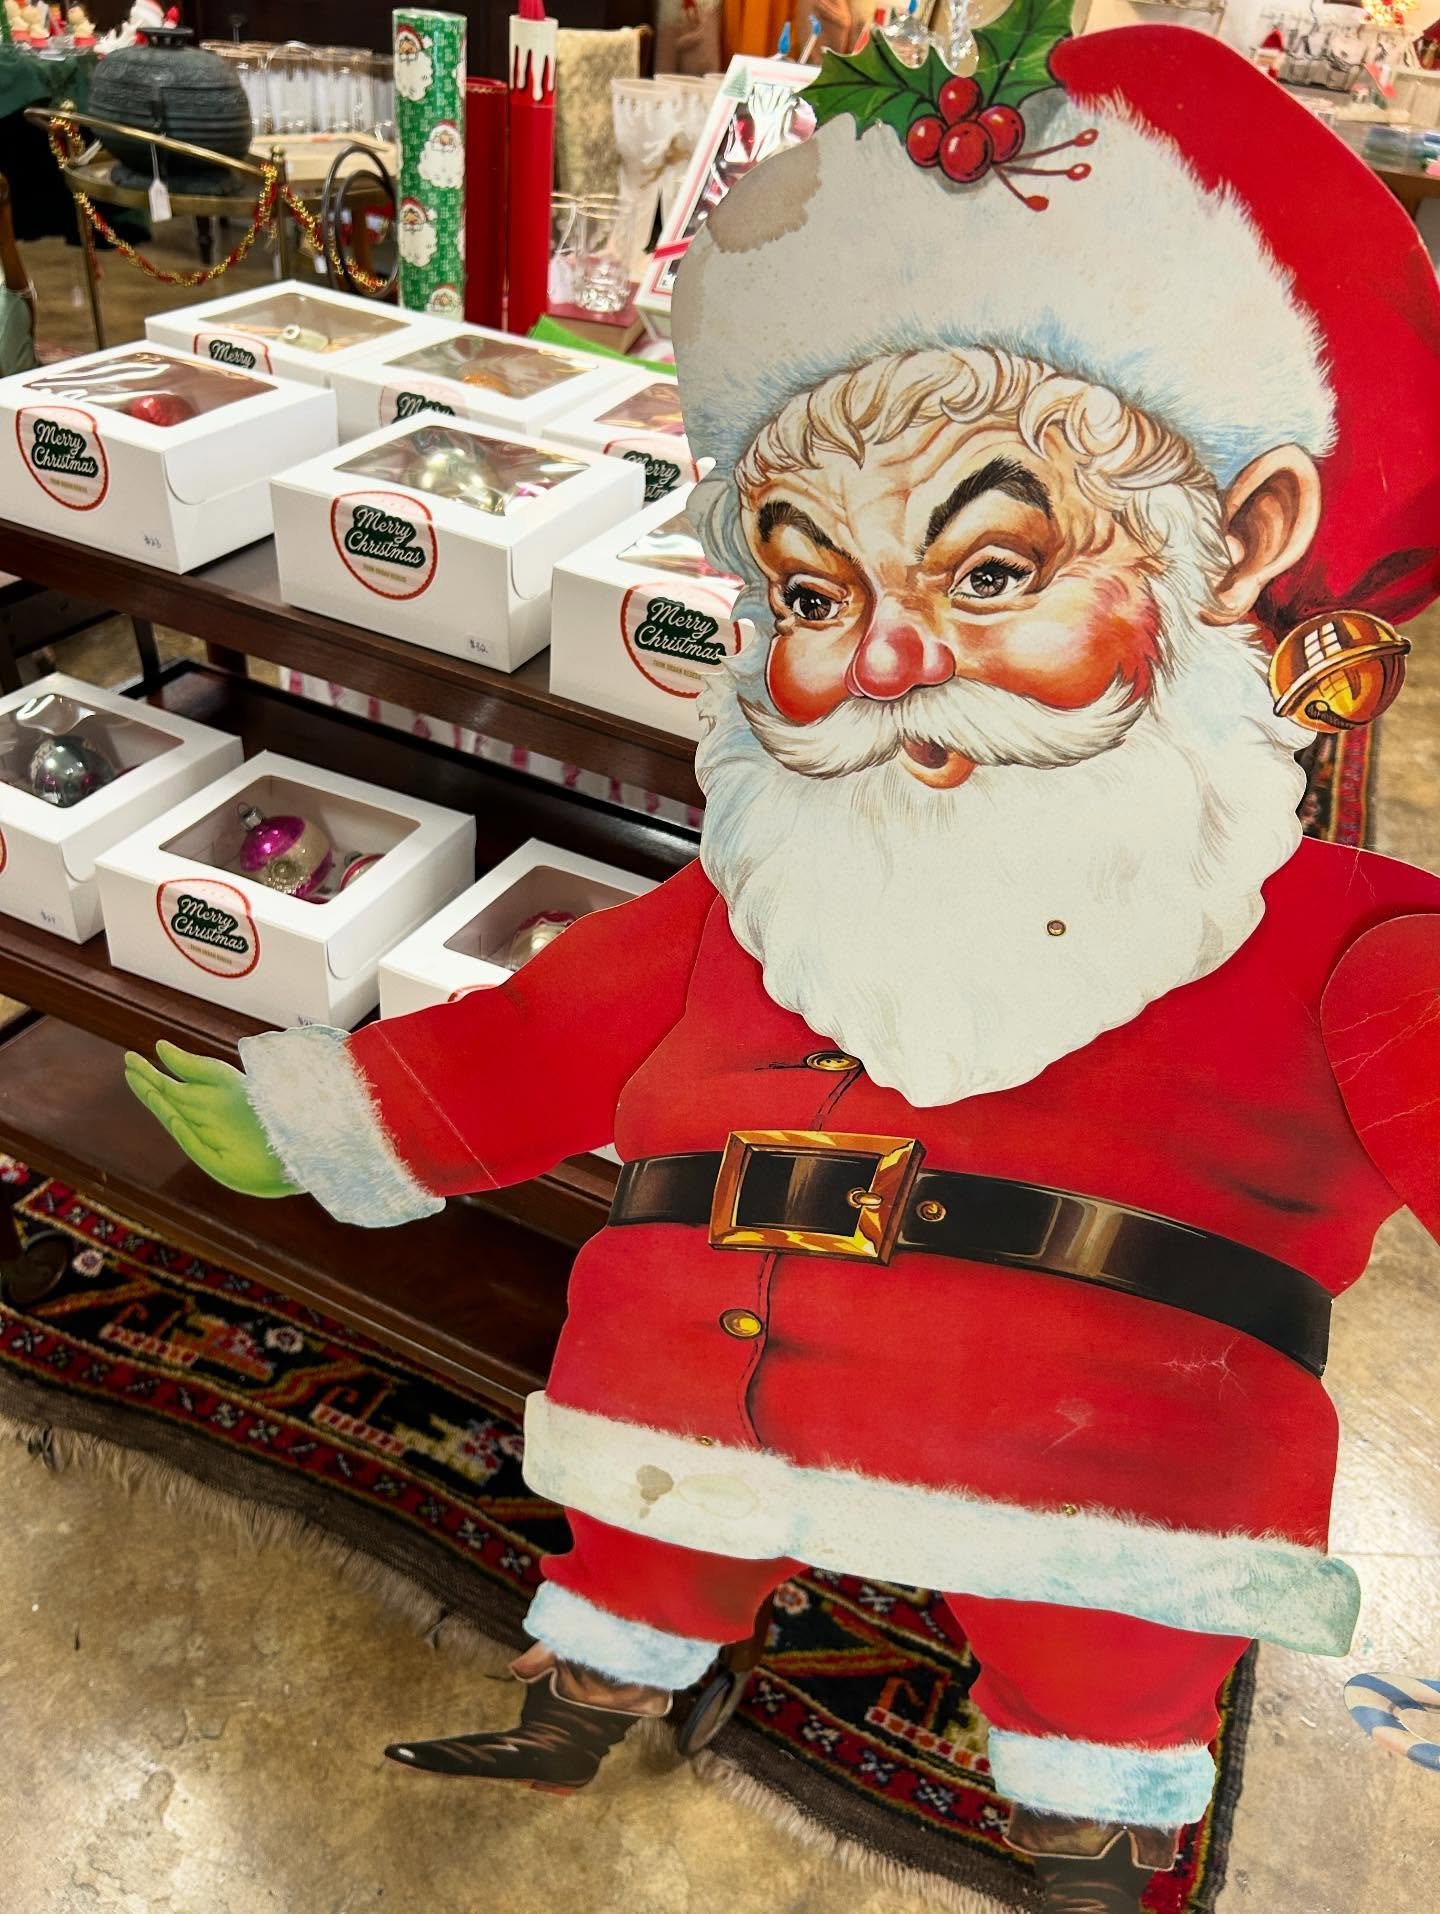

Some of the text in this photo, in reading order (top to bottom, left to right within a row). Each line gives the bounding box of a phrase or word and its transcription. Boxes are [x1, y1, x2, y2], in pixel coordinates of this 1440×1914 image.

[212, 341, 253, 367] Merry
[36, 423, 84, 456] Merry
[34, 446, 96, 474] Christmas
[355, 508, 412, 543] Merry
[347, 531, 422, 564] Christmas
[651, 602, 714, 639] Merry
[638, 625, 722, 660] Christmas
[175, 916, 245, 951] Christmas
[181, 899, 235, 934] Merry
